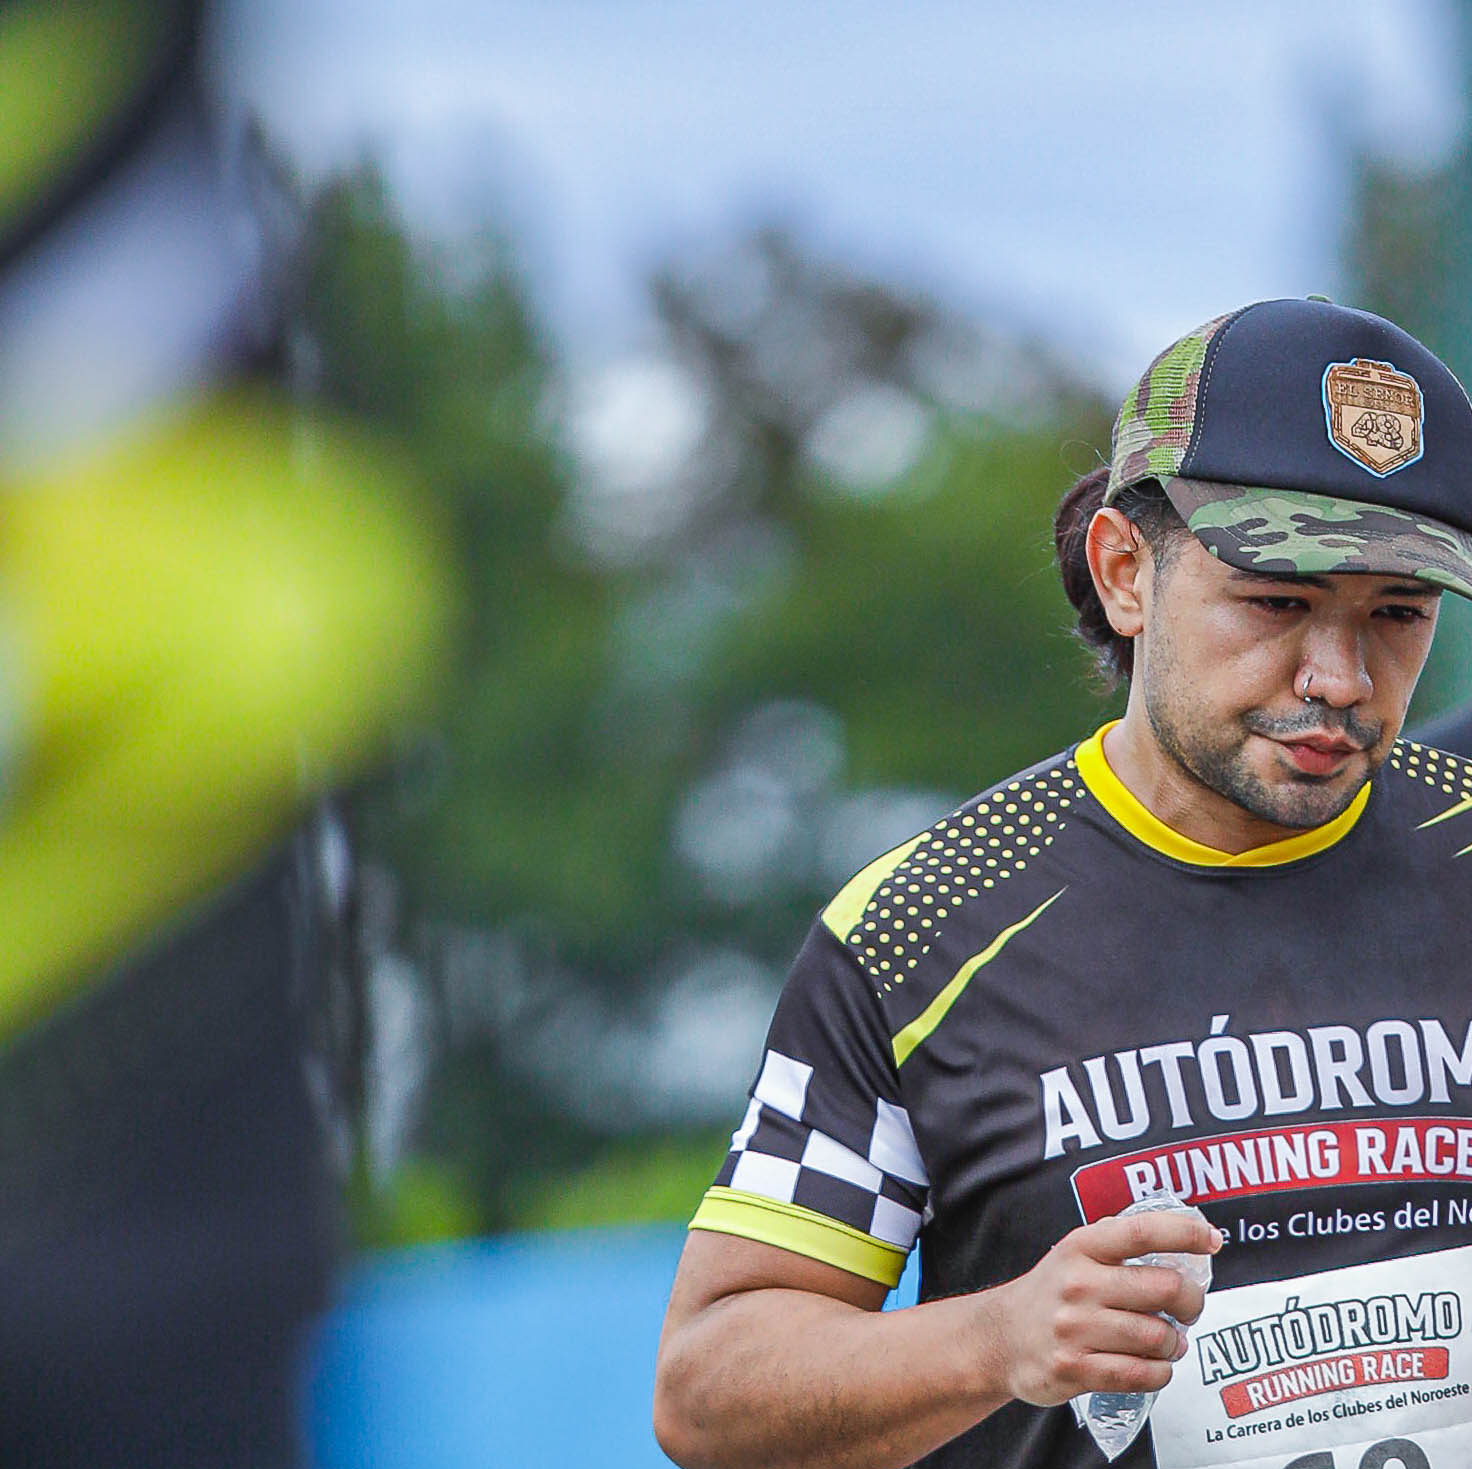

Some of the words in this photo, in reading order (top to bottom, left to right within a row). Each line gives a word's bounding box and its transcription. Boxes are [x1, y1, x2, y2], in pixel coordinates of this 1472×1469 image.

[1336, 382, 1359, 397] EL
[1122, 1128, 1341, 1203] RUNNING
[1239, 1217, 1280, 1243] los
[1288, 1204, 1385, 1237] Clubes
[1393, 1200, 1440, 1231] del
[1197, 1291, 1462, 1386] AUTÓDROMO
[1245, 1358, 1355, 1411] RUNNING
[1363, 1352, 1425, 1382] RACE
[1206, 1427, 1224, 1444] La
[1226, 1417, 1283, 1441] Carrera
[1285, 1411, 1305, 1429] de
[1308, 1407, 1330, 1426] los
[1332, 1399, 1383, 1420] Clubes
[1385, 1394, 1409, 1412] del
[1411, 1381, 1471, 1407] Noroeste
